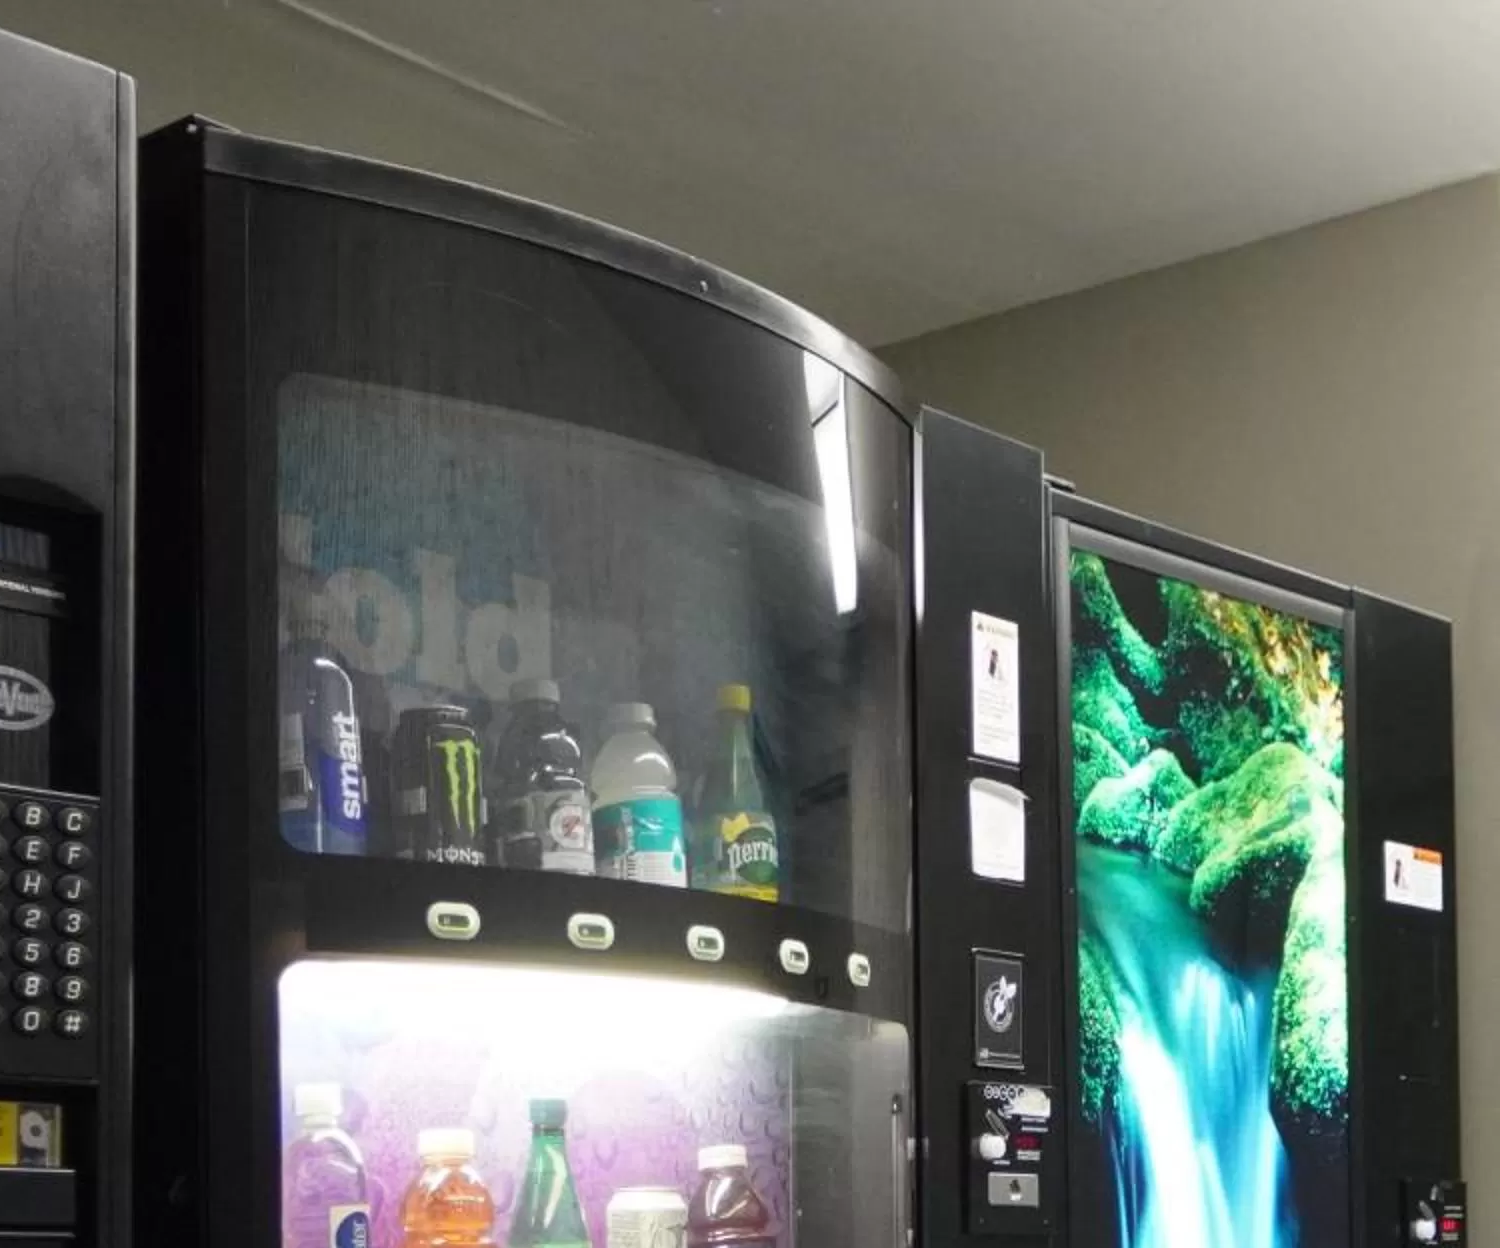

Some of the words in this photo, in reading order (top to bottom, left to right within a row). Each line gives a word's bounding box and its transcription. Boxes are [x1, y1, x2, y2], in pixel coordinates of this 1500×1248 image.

[332, 711, 362, 820] smart
[25, 807, 41, 826] B
[67, 813, 82, 832] C
[26, 840, 41, 861] E
[67, 846, 82, 866] F
[23, 875, 42, 895] H
[67, 879, 82, 899] J
[24, 909, 41, 929] 2
[65, 913, 82, 933] 3
[24, 943, 41, 962] 5
[66, 947, 81, 966] 6
[24, 977, 41, 996] 8
[65, 980, 82, 1000] 9
[23, 1010, 40, 1031] 0
